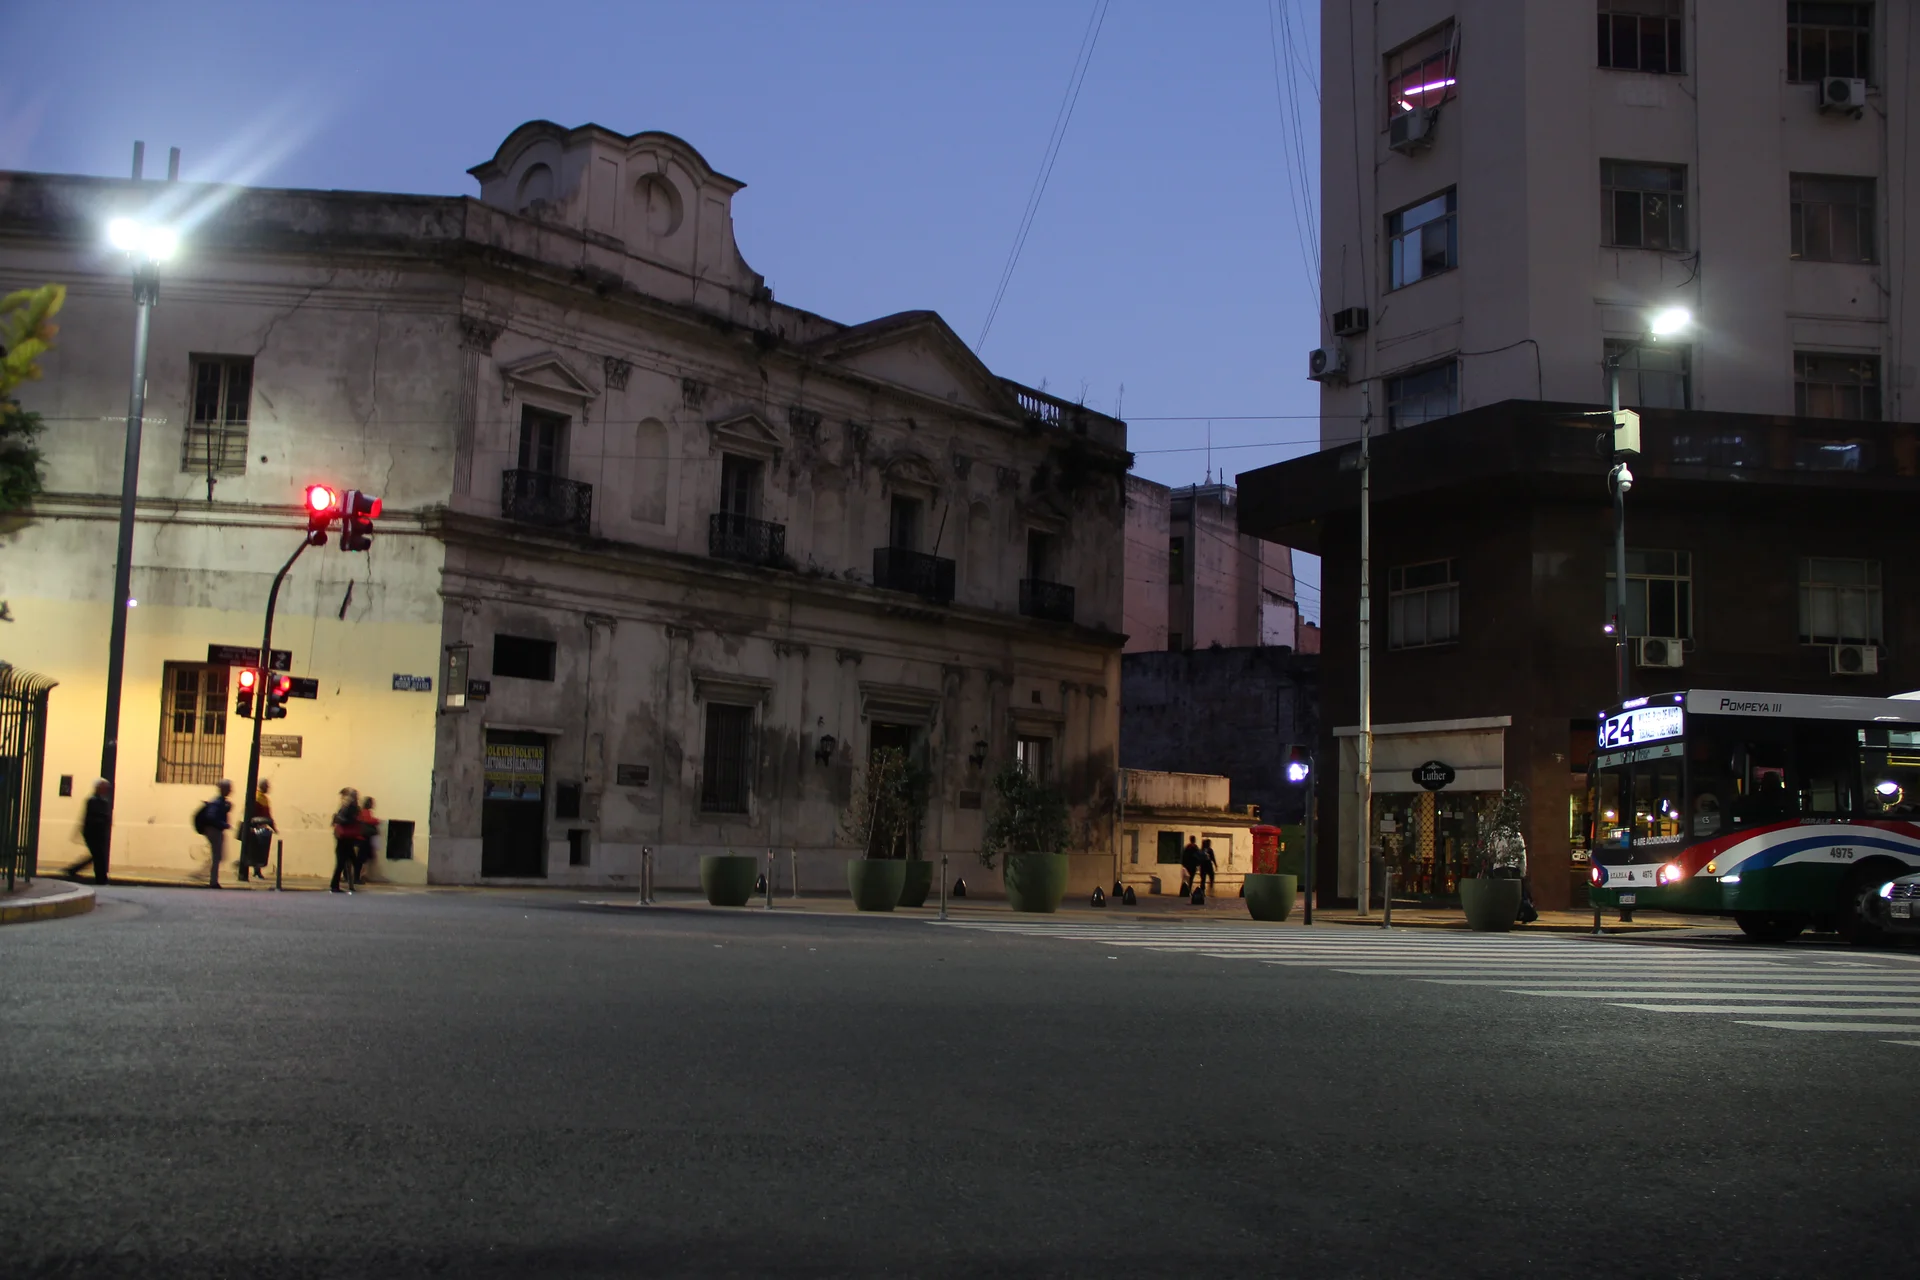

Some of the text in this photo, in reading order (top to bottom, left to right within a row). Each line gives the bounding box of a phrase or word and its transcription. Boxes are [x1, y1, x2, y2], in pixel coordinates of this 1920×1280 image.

[1720, 698, 1782, 713] POMPEYA III
[1607, 715, 1634, 747] 24
[486, 745, 513, 757] OLETAS
[1421, 770, 1446, 781] Luther
[1830, 847, 1853, 859] 4975
